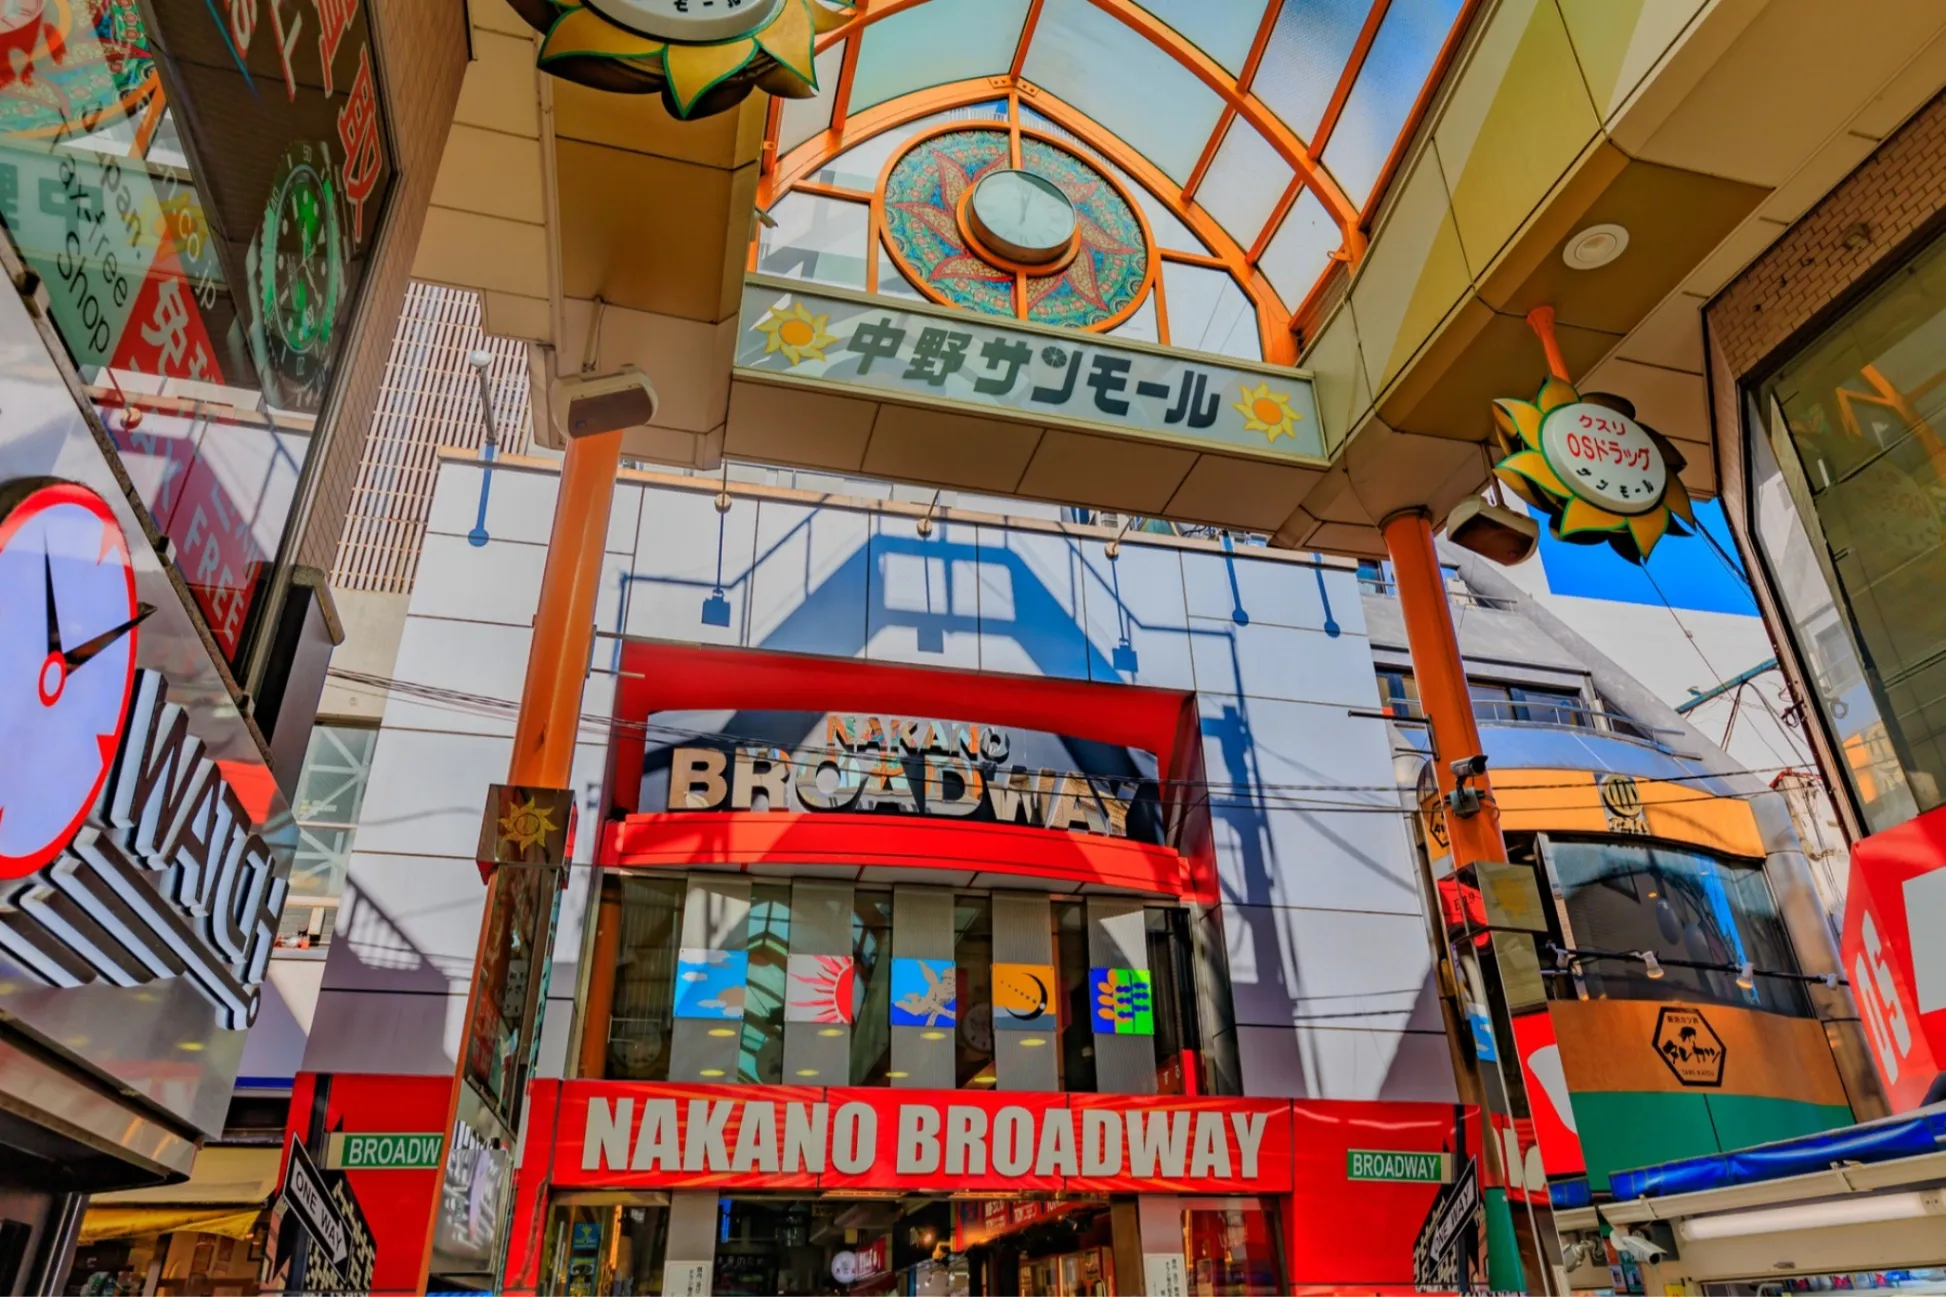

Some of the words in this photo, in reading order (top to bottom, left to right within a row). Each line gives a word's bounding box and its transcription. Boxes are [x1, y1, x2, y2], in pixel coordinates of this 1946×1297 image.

[56, 230, 111, 354] Shop
[846, 317, 1221, 429] 中野サンモール
[1579, 414, 1626, 436] クスリ
[826, 713, 1011, 764] NAKANO
[109, 668, 290, 985] WATCH
[667, 746, 1139, 837] BROADWAY
[581, 1096, 877, 1175] NAKANO
[896, 1104, 1270, 1180] BROADWAY
[1353, 1151, 1438, 1179] BROADWAY
[295, 1171, 317, 1215] ONE
[320, 1208, 342, 1251] WAY
[1434, 1224, 1450, 1254] ONE
[1450, 1185, 1472, 1229] WAY
